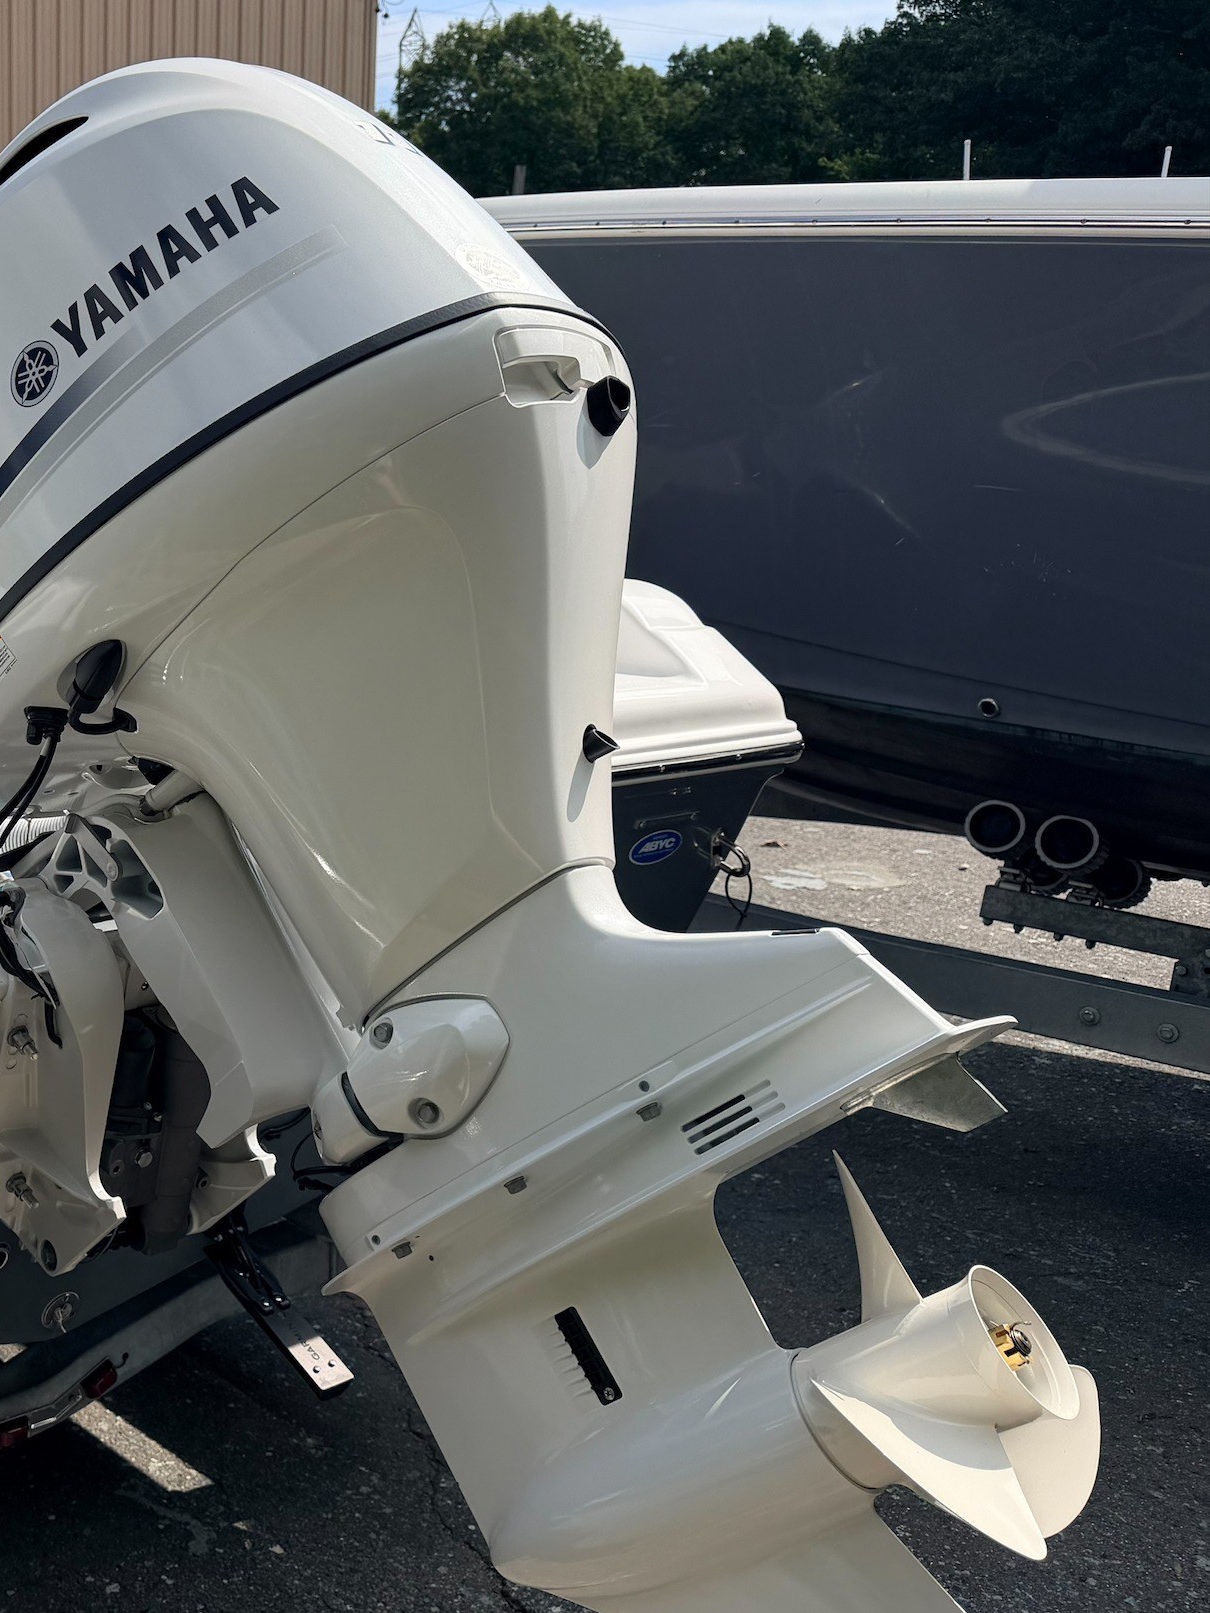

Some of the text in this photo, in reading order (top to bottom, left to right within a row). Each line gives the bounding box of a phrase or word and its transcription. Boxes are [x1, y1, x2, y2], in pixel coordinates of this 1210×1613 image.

[50, 176, 280, 358] YAMAHA
[638, 838, 676, 853] ABYC
[288, 1322, 320, 1360] GARMIN
